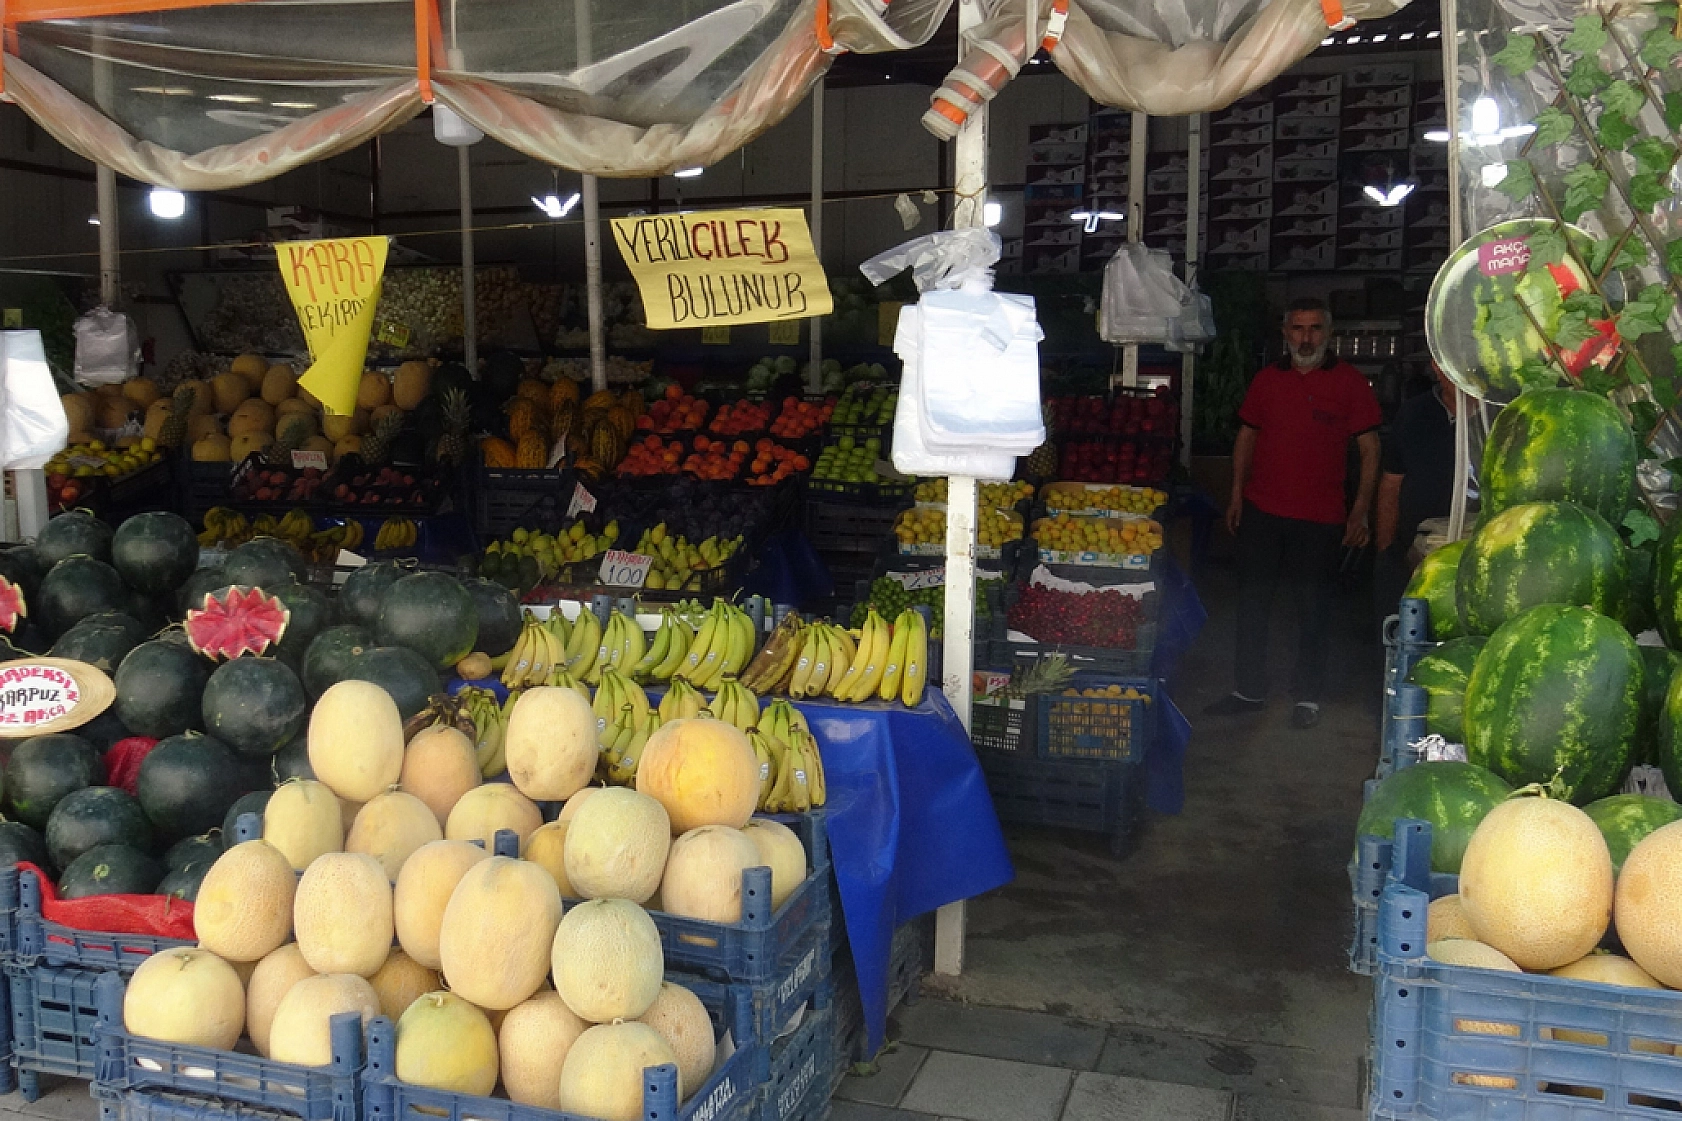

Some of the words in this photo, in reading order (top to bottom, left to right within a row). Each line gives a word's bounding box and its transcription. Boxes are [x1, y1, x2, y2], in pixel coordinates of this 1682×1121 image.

[288, 240, 377, 303] KARA
[666, 272, 807, 323] BULUNUR
[607, 564, 643, 585] 100
